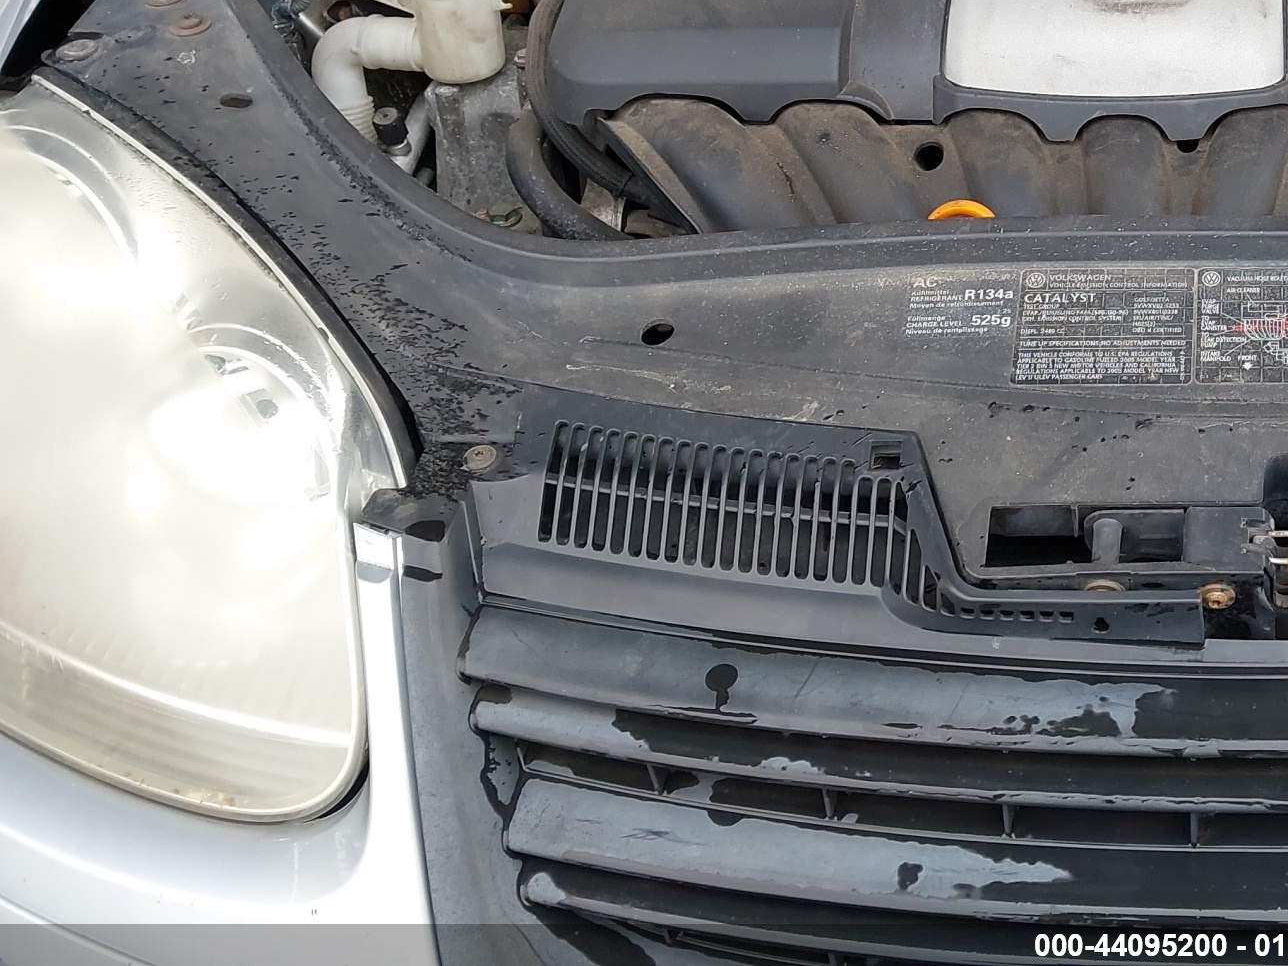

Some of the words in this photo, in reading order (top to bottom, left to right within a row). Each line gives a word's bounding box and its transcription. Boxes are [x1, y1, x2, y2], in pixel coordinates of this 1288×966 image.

[913, 276, 938, 288] AC
[1049, 274, 1112, 282] VOLKSWAGEN
[911, 294, 963, 302] REFRIGERANT
[965, 288, 1014, 300] R134a
[1023, 293, 1096, 303] CATALYST
[910, 301, 934, 309] Moyen
[907, 315, 946, 323] Füllmenge
[971, 315, 1012, 327] 525g
[905, 327, 932, 335] Niveau
